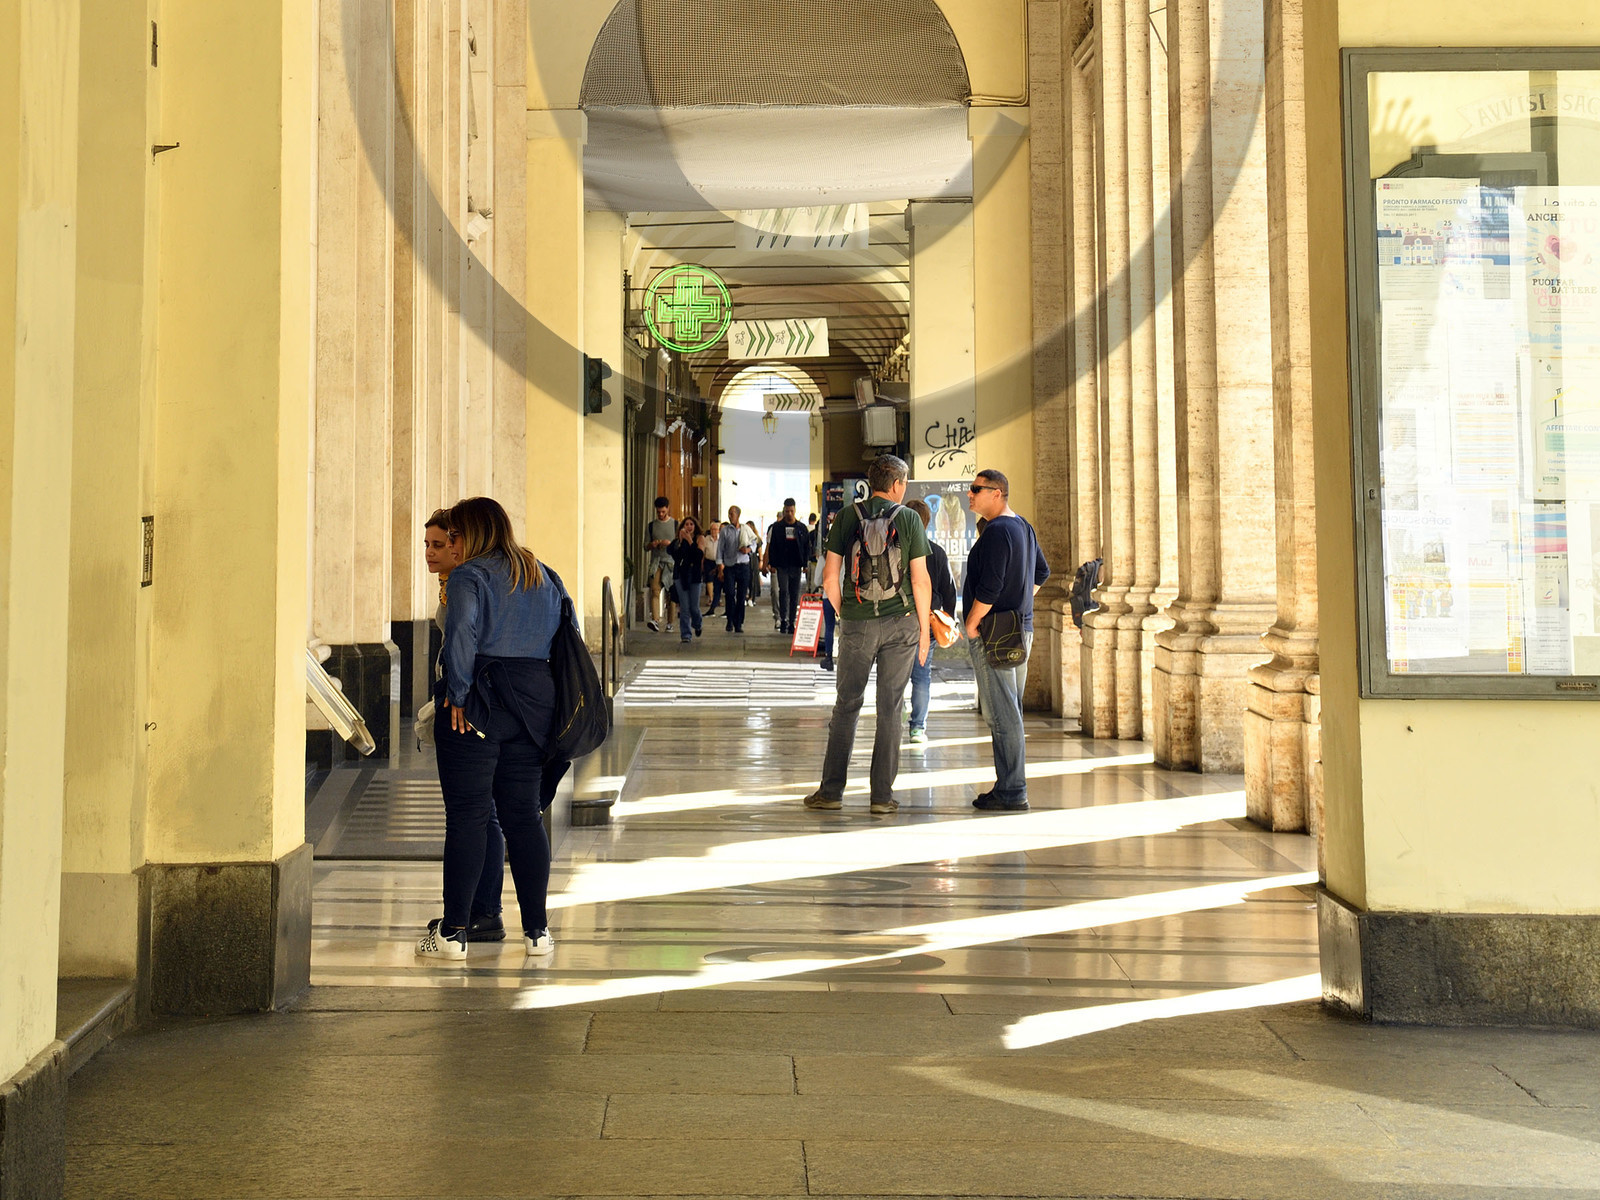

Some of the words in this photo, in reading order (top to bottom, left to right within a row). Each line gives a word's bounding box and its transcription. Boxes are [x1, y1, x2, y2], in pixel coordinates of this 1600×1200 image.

[1478, 92, 1547, 126] AVVISI
[1527, 213, 1565, 221] ANCHE
[1532, 278, 1554, 286] PUOI
[1556, 278, 1574, 286] FAR
[1551, 286, 1598, 294] BATTERE
[1537, 295, 1592, 307] CUORE
